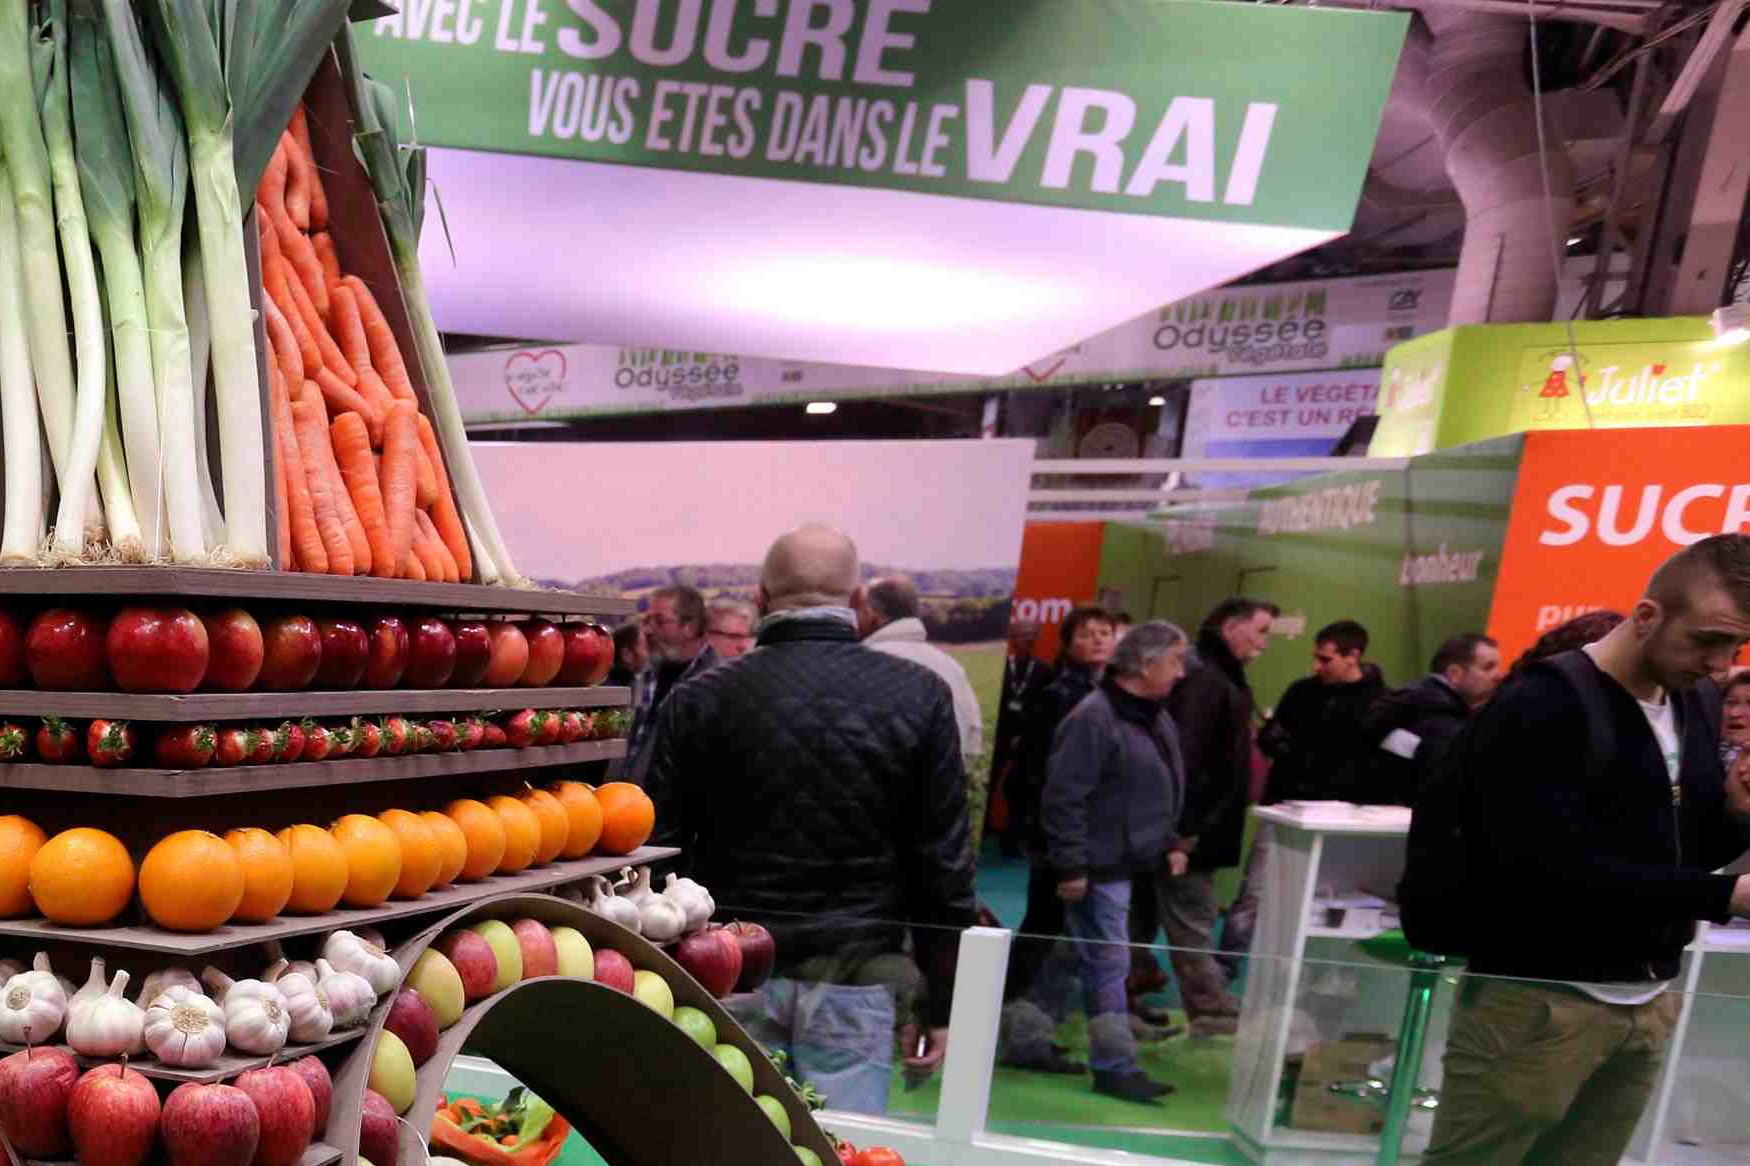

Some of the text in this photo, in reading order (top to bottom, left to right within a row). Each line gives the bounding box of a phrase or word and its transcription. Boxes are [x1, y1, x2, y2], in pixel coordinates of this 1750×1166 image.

[495, 0, 548, 54] LE
[555, 0, 933, 88] SUCRE
[527, 68, 1279, 206] VOUS ETES DANS LE VRAI
[1153, 312, 1327, 354] Odyssée
[614, 362, 740, 391] Odyssée
[1260, 385, 1289, 405] LE
[1585, 362, 1708, 407] Juliet
[1297, 409, 1330, 426] UN
